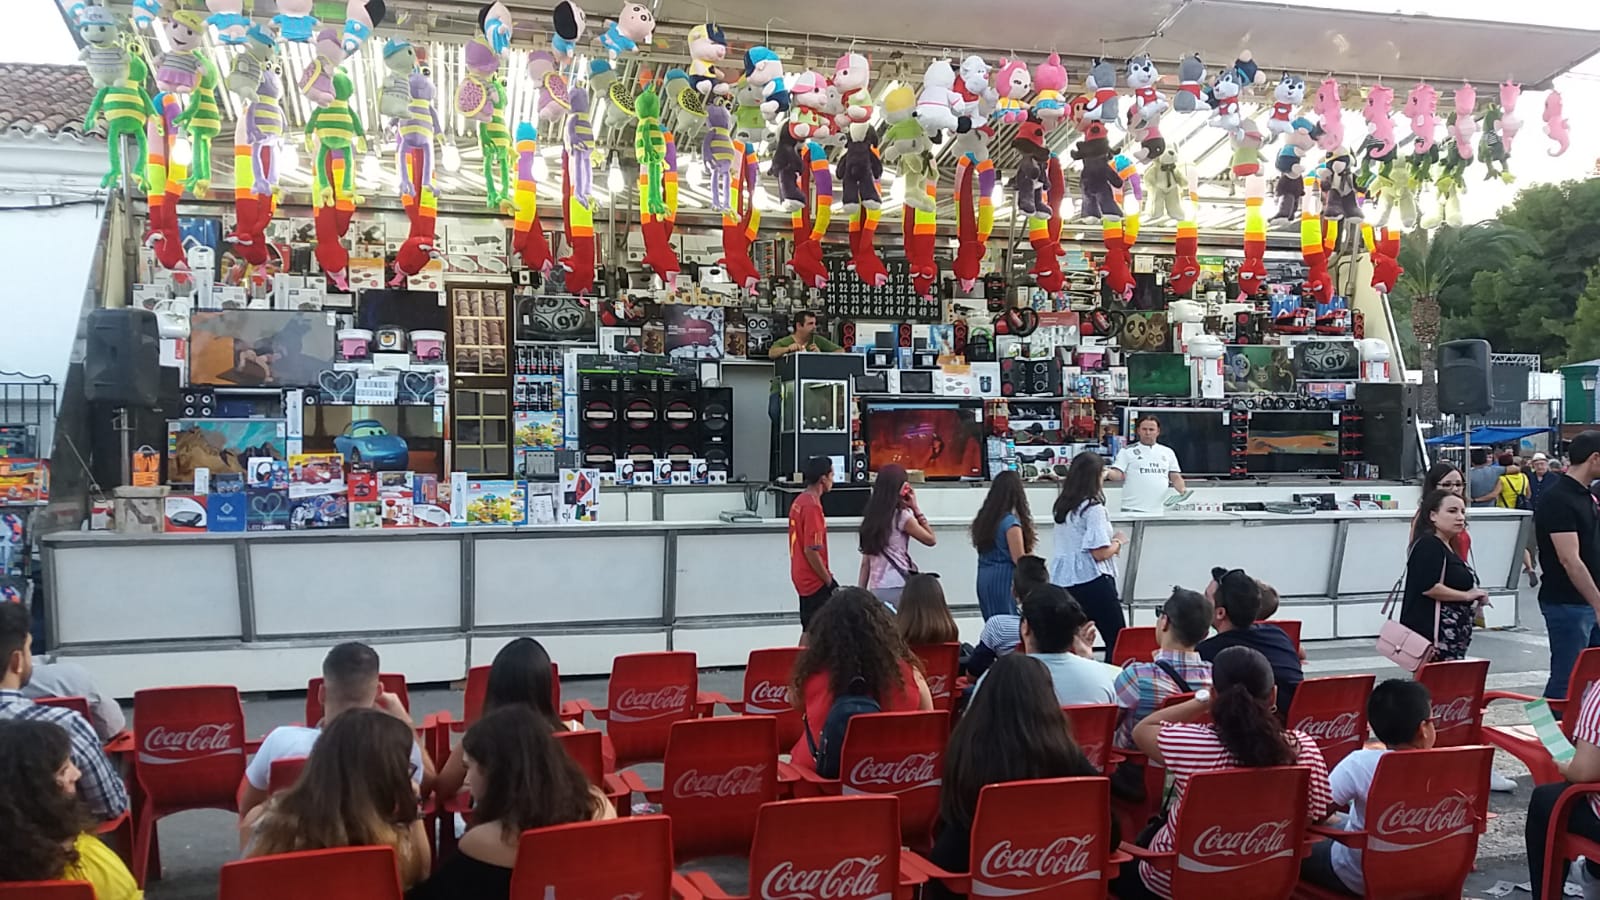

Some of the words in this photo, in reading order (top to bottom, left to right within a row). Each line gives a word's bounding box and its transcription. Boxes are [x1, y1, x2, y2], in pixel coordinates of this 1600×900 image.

[828, 271, 835, 281] 11
[838, 272, 847, 282] 12
[850, 272, 859, 282] 13
[896, 274, 904, 284] 17
[827, 283, 836, 292] 21
[839, 283, 848, 293] 22
[850, 283, 859, 293] 23
[862, 284, 870, 293] 24
[885, 285, 894, 294] 26
[896, 285, 905, 294] 27
[827, 294, 836, 304] 31
[839, 294, 848, 304] 32
[851, 295, 860, 305] 33
[862, 295, 870, 305] 34
[873, 295, 882, 305] 35
[885, 296, 894, 305] 36
[896, 296, 905, 305] 37
[908, 296, 916, 305] 38
[828, 305, 836, 315] 41
[839, 305, 848, 315] 42
[851, 305, 860, 315] 43
[862, 305, 871, 315] 44
[874, 306, 882, 316] 45
[885, 306, 894, 316] 46
[896, 306, 905, 316] 47
[908, 307, 916, 316] 48
[919, 307, 928, 316] 49
[930, 307, 938, 317] 50
